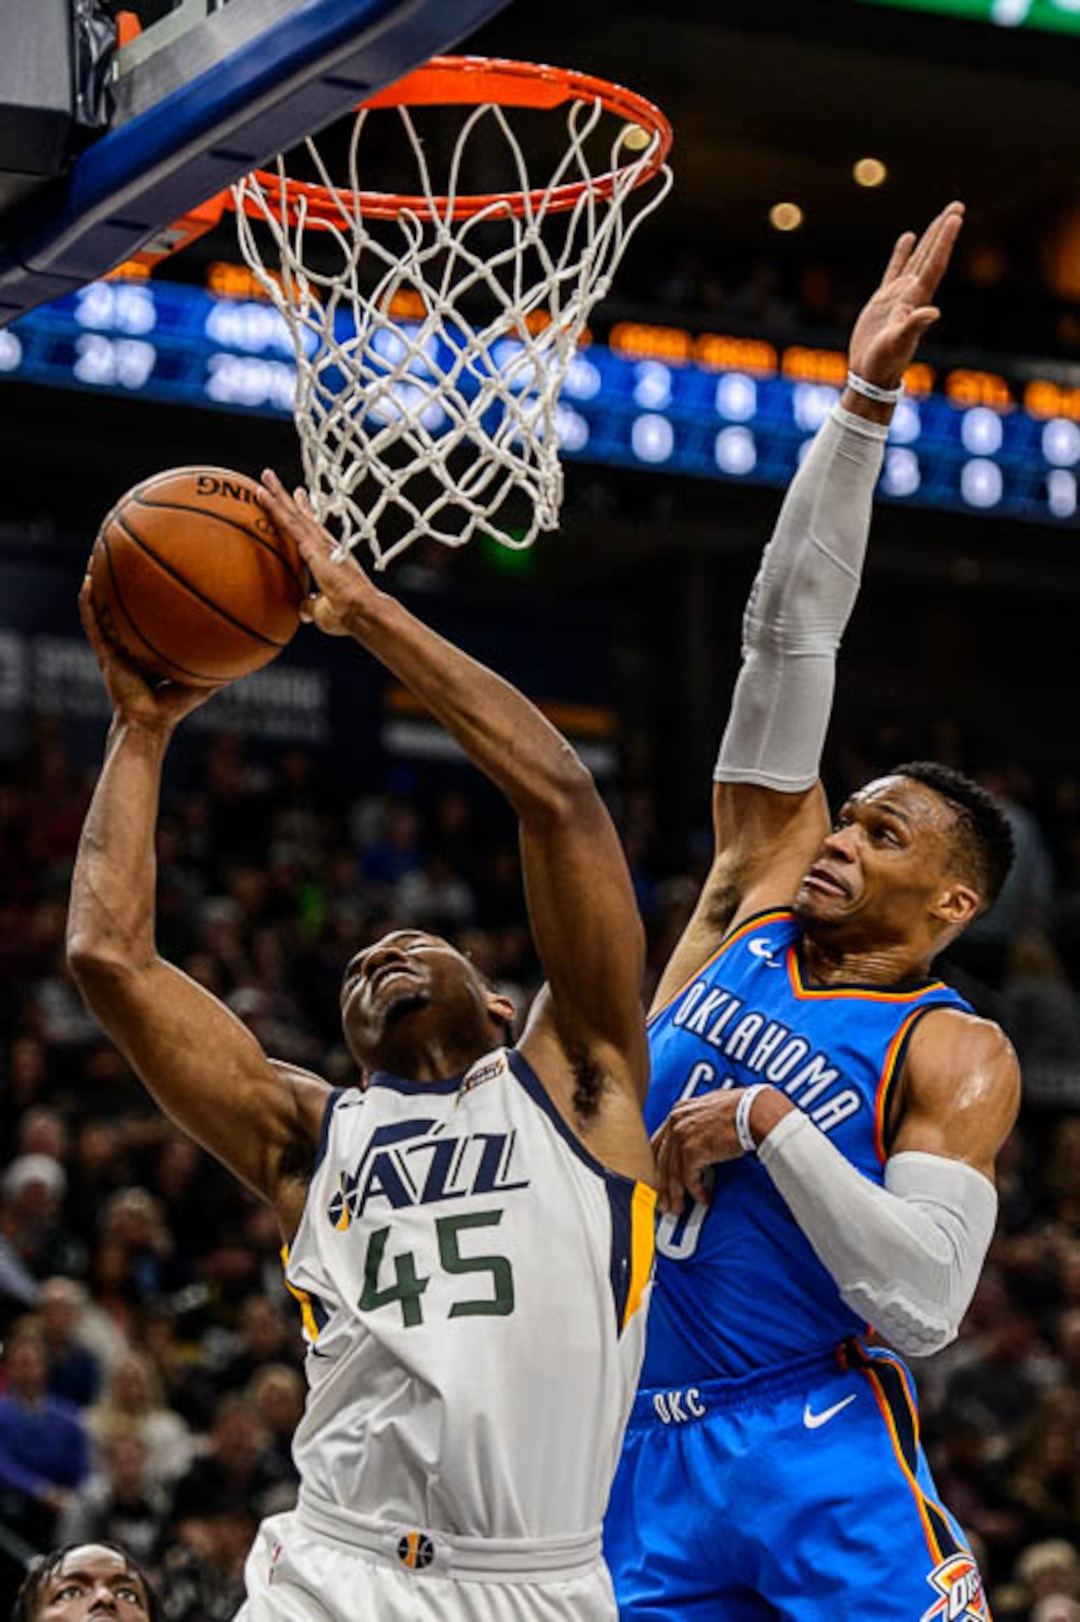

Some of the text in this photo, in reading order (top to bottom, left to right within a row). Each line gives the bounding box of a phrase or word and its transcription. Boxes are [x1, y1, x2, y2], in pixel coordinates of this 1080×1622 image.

[672, 979, 862, 1133] OKLAHOMA
[327, 1118, 531, 1231] JAZZ
[357, 1209, 516, 1329] 45
[652, 1388, 706, 1425] OKC
